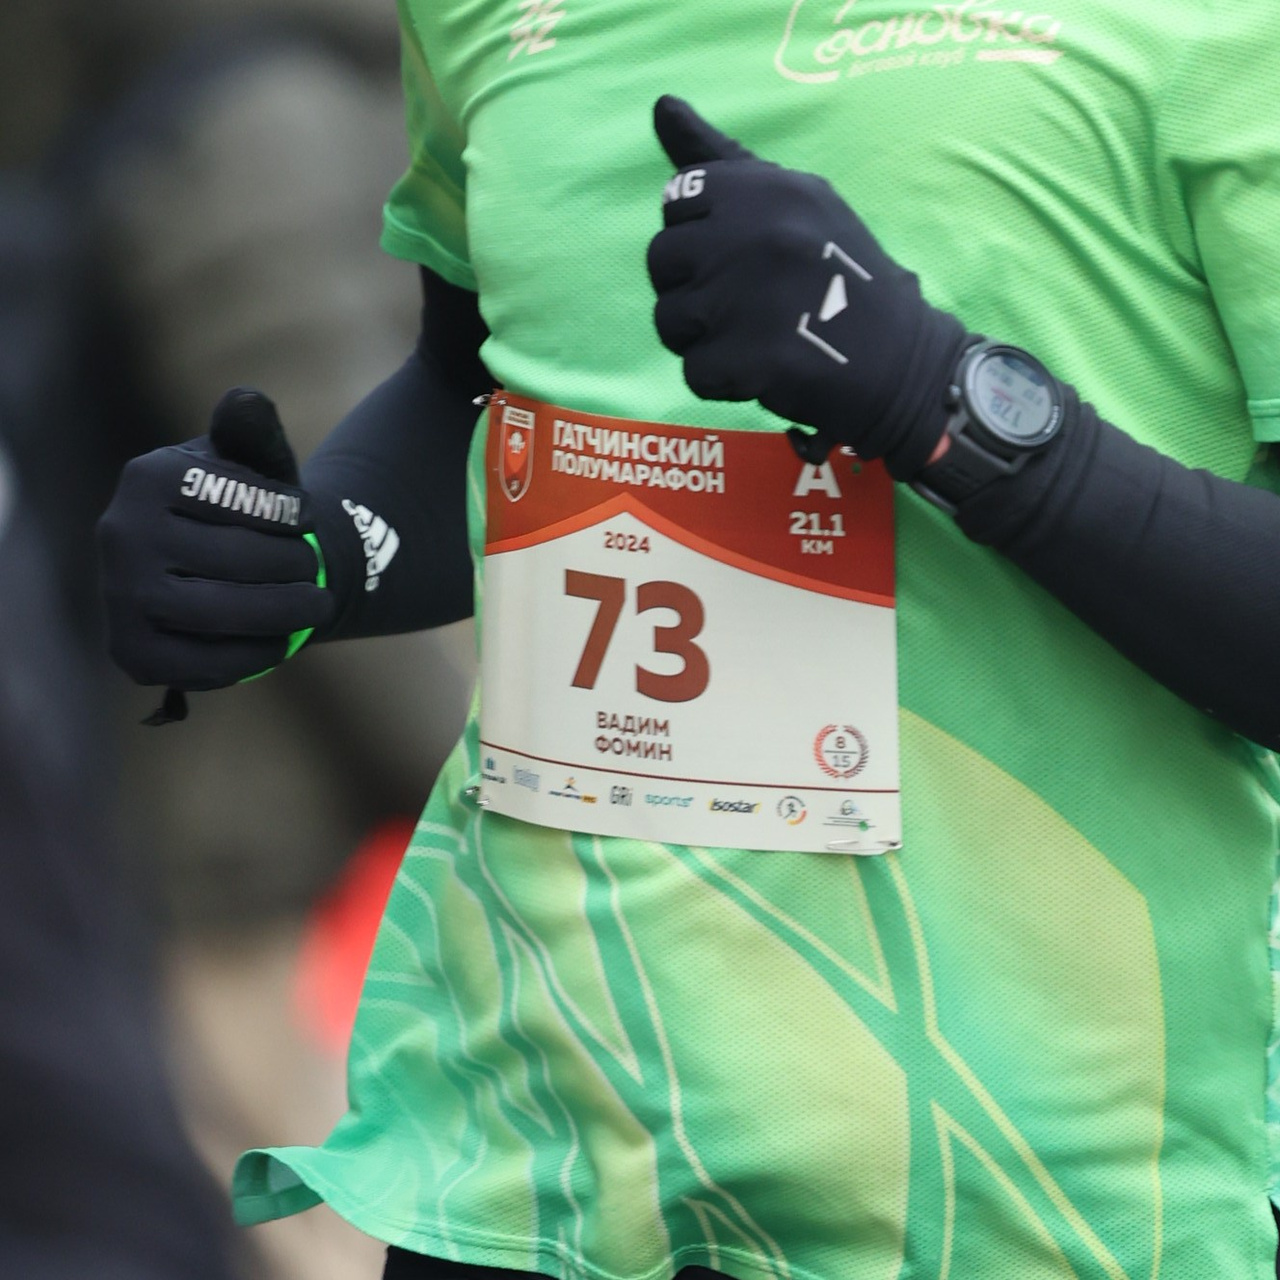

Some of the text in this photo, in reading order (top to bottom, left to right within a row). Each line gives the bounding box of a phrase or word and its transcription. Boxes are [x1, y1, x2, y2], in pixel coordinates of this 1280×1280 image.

[552, 419, 725, 469] ГАТЧИНСКИЙ
[551, 449, 725, 494] ПОЛУМАРАФОН
[180, 466, 300, 527] RUNNING
[788, 510, 847, 538] 21.1
[341, 499, 398, 592] adidas
[603, 531, 651, 554] 2024
[801, 539, 834, 556] КМ
[563, 568, 711, 704] 73
[596, 710, 671, 738] ВАДИМ
[594, 734, 674, 762] ФОМИН
[835, 735, 846, 750] 8
[832, 754, 851, 769] 15
[709, 797, 758, 814] isostar
